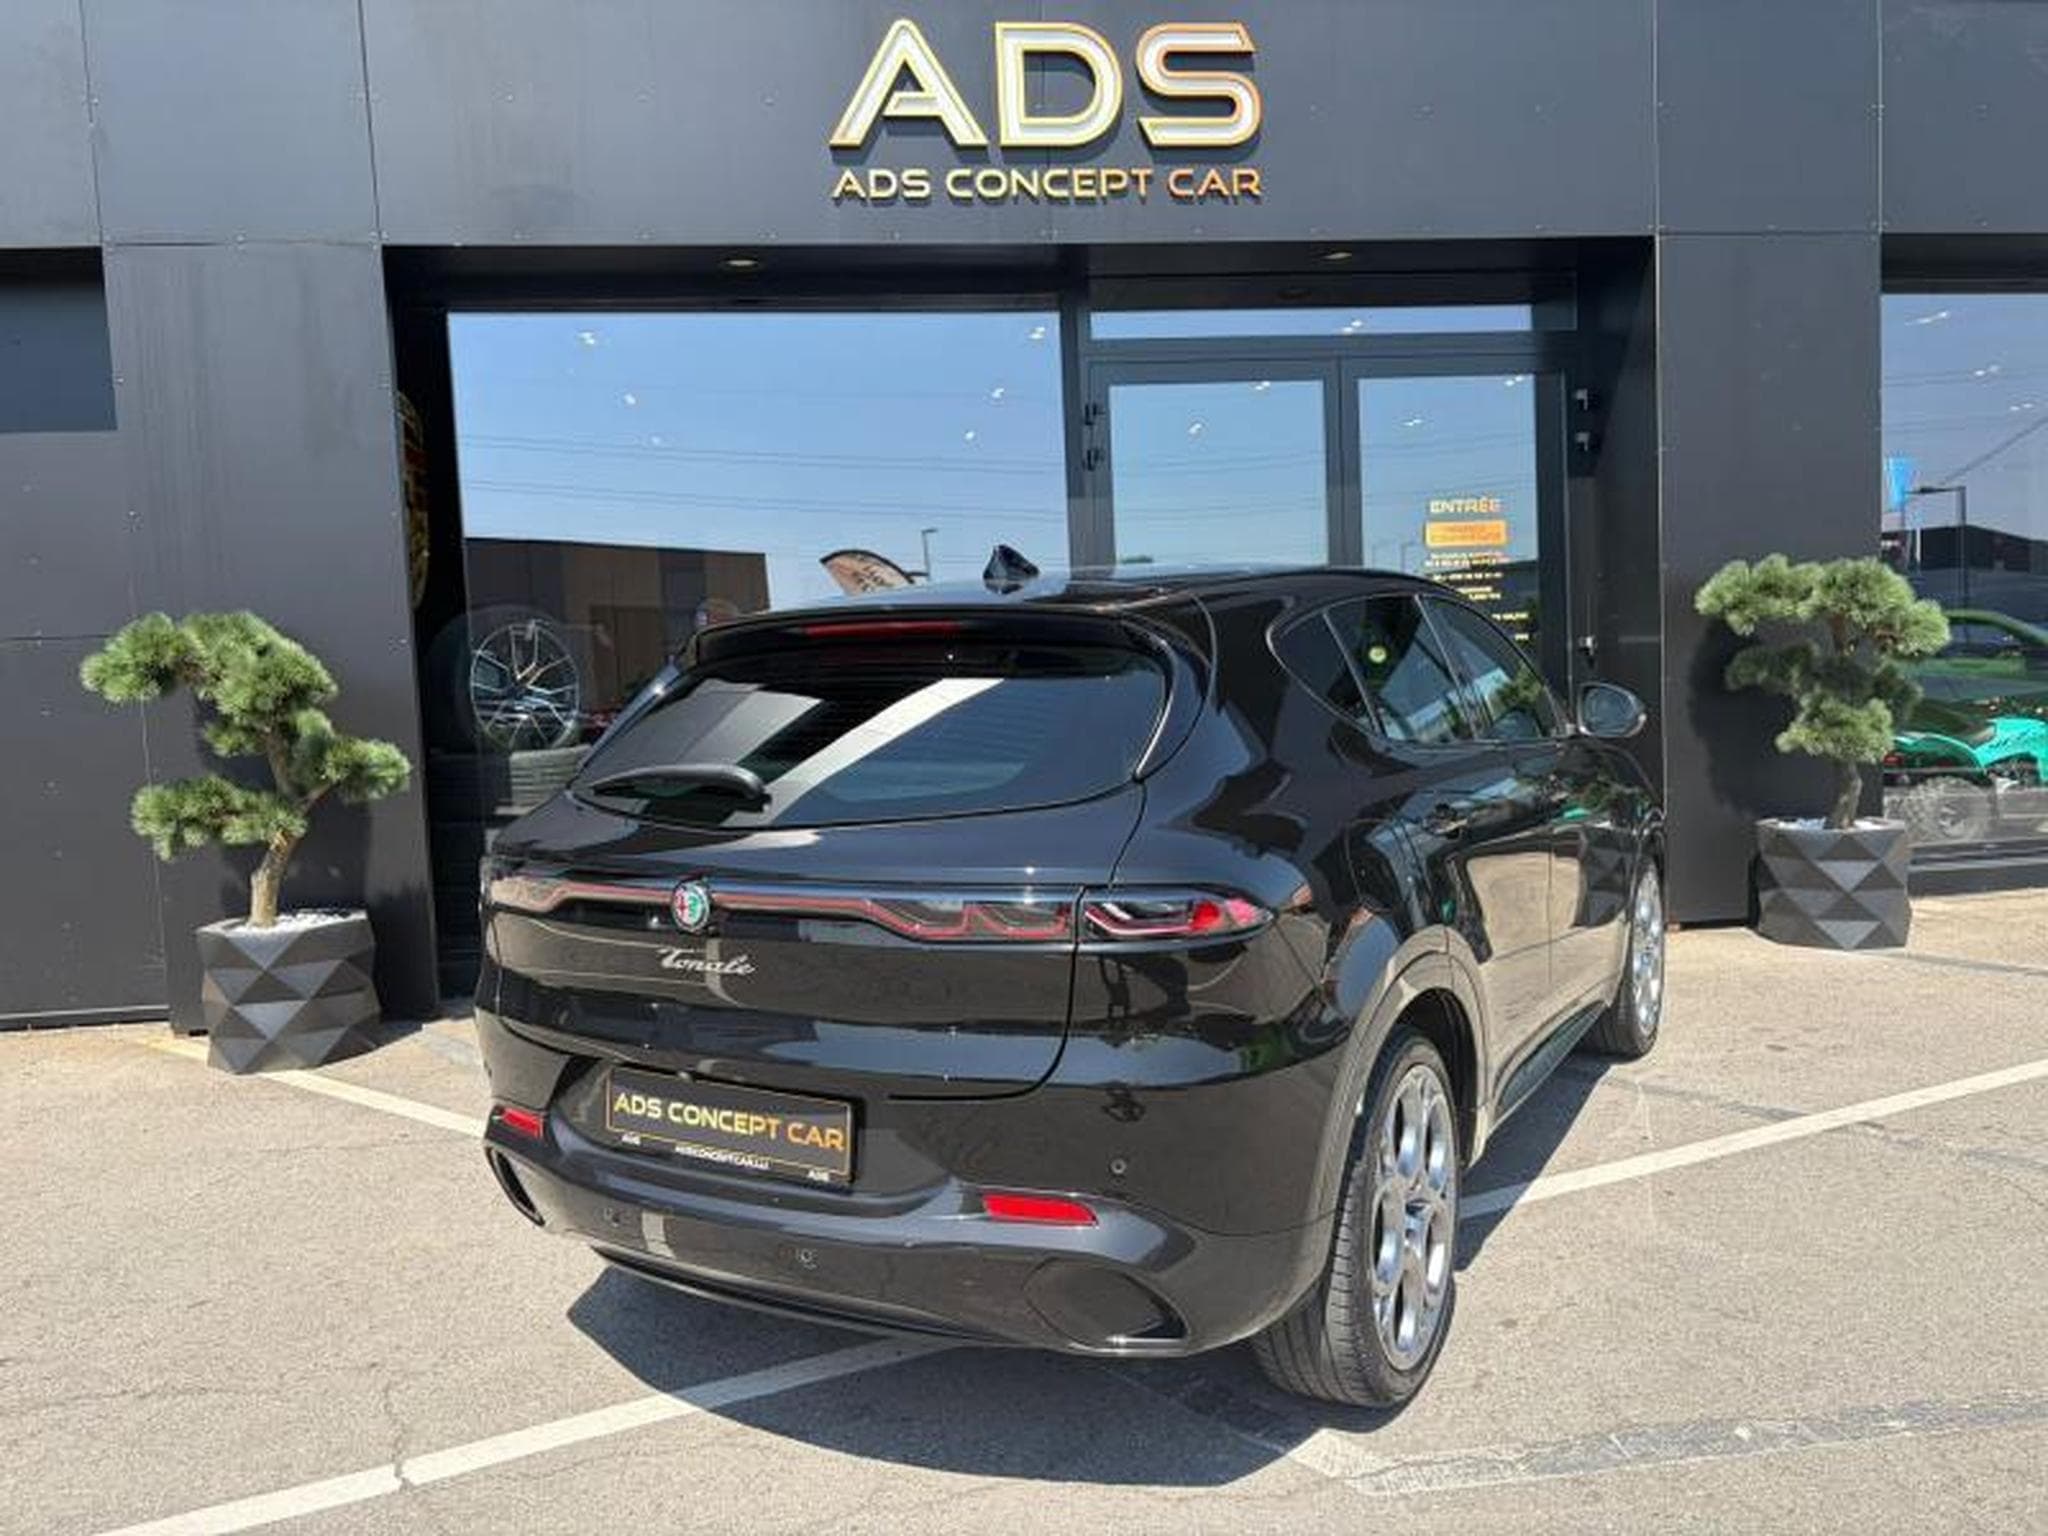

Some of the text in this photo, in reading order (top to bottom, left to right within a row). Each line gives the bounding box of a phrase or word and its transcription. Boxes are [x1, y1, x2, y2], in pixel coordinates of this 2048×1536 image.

[830, 18, 1262, 147] ADS
[832, 168, 1262, 198] ADS CONCEPT CAR
[614, 1092, 662, 1118] ADS
[668, 1102, 781, 1140] CONCEPT
[788, 1122, 844, 1150] CAR
